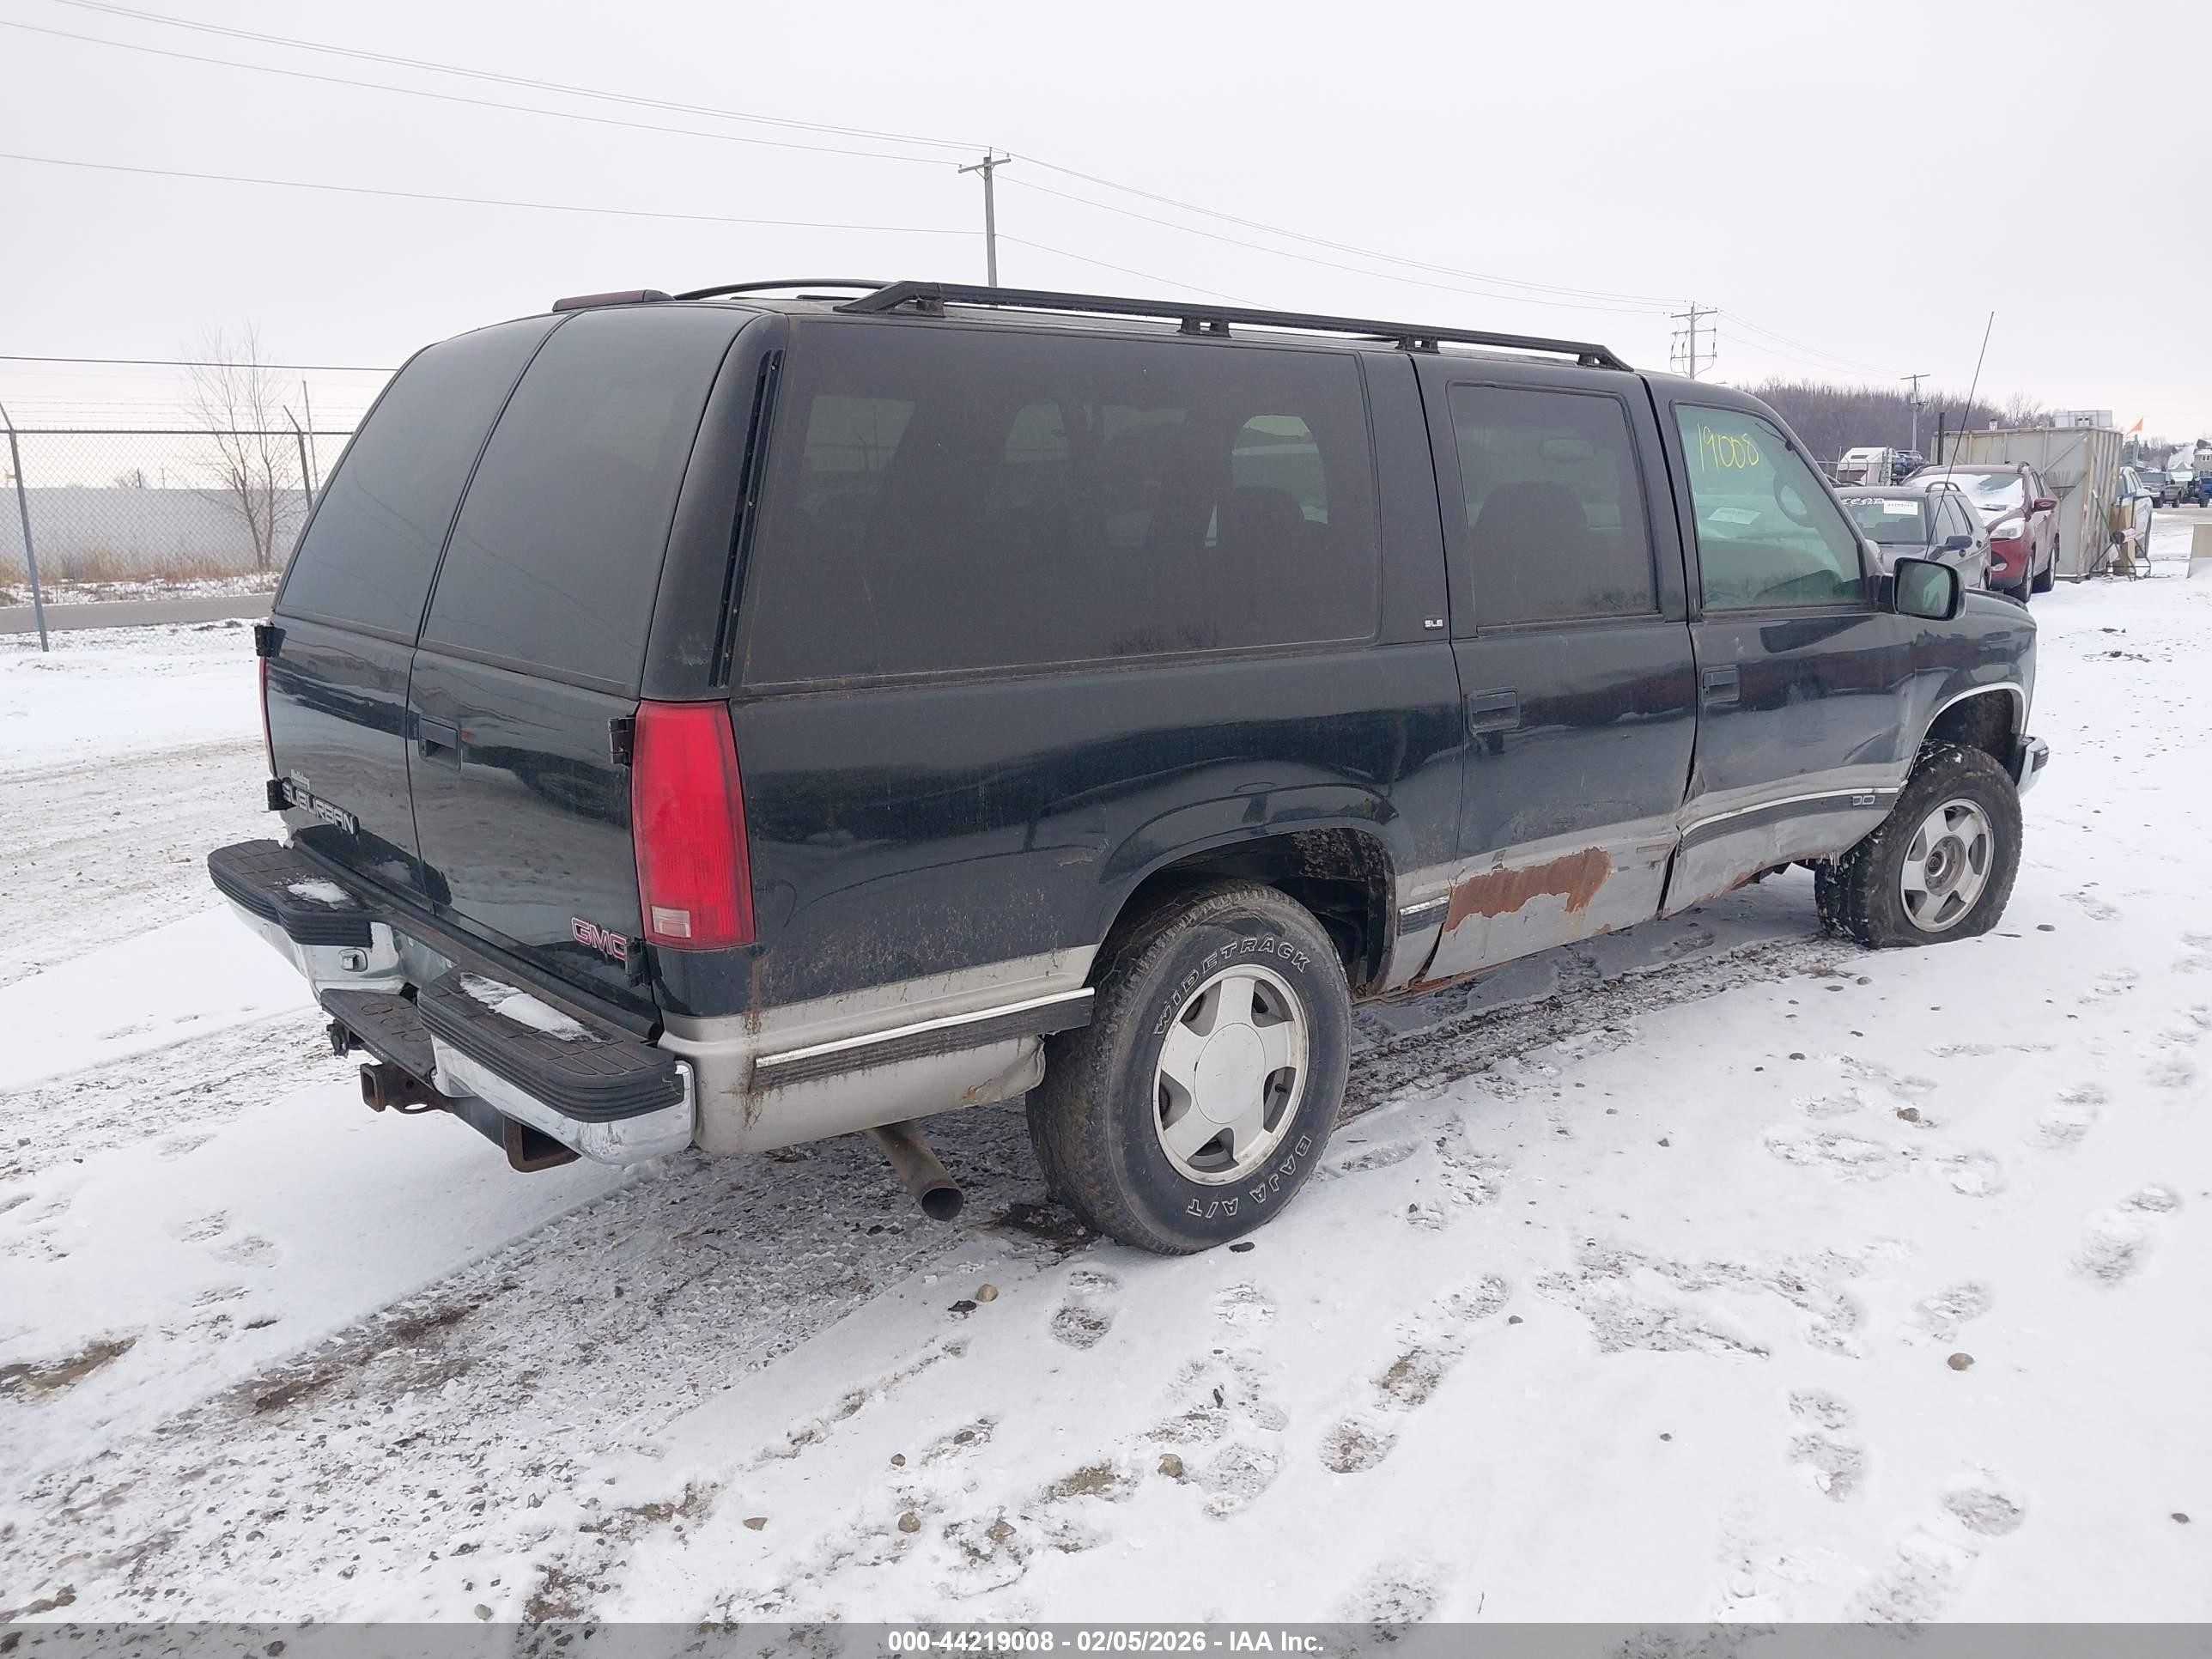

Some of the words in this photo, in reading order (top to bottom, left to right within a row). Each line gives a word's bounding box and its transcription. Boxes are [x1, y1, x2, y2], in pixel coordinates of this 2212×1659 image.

[282, 781, 355, 835] SUBURBAN
[571, 917, 627, 961] GMC
[1153, 938, 1310, 1035] WIDETRACK
[1249, 1135, 1312, 1203] BAJA
[1188, 1197, 1239, 1218] A/T
